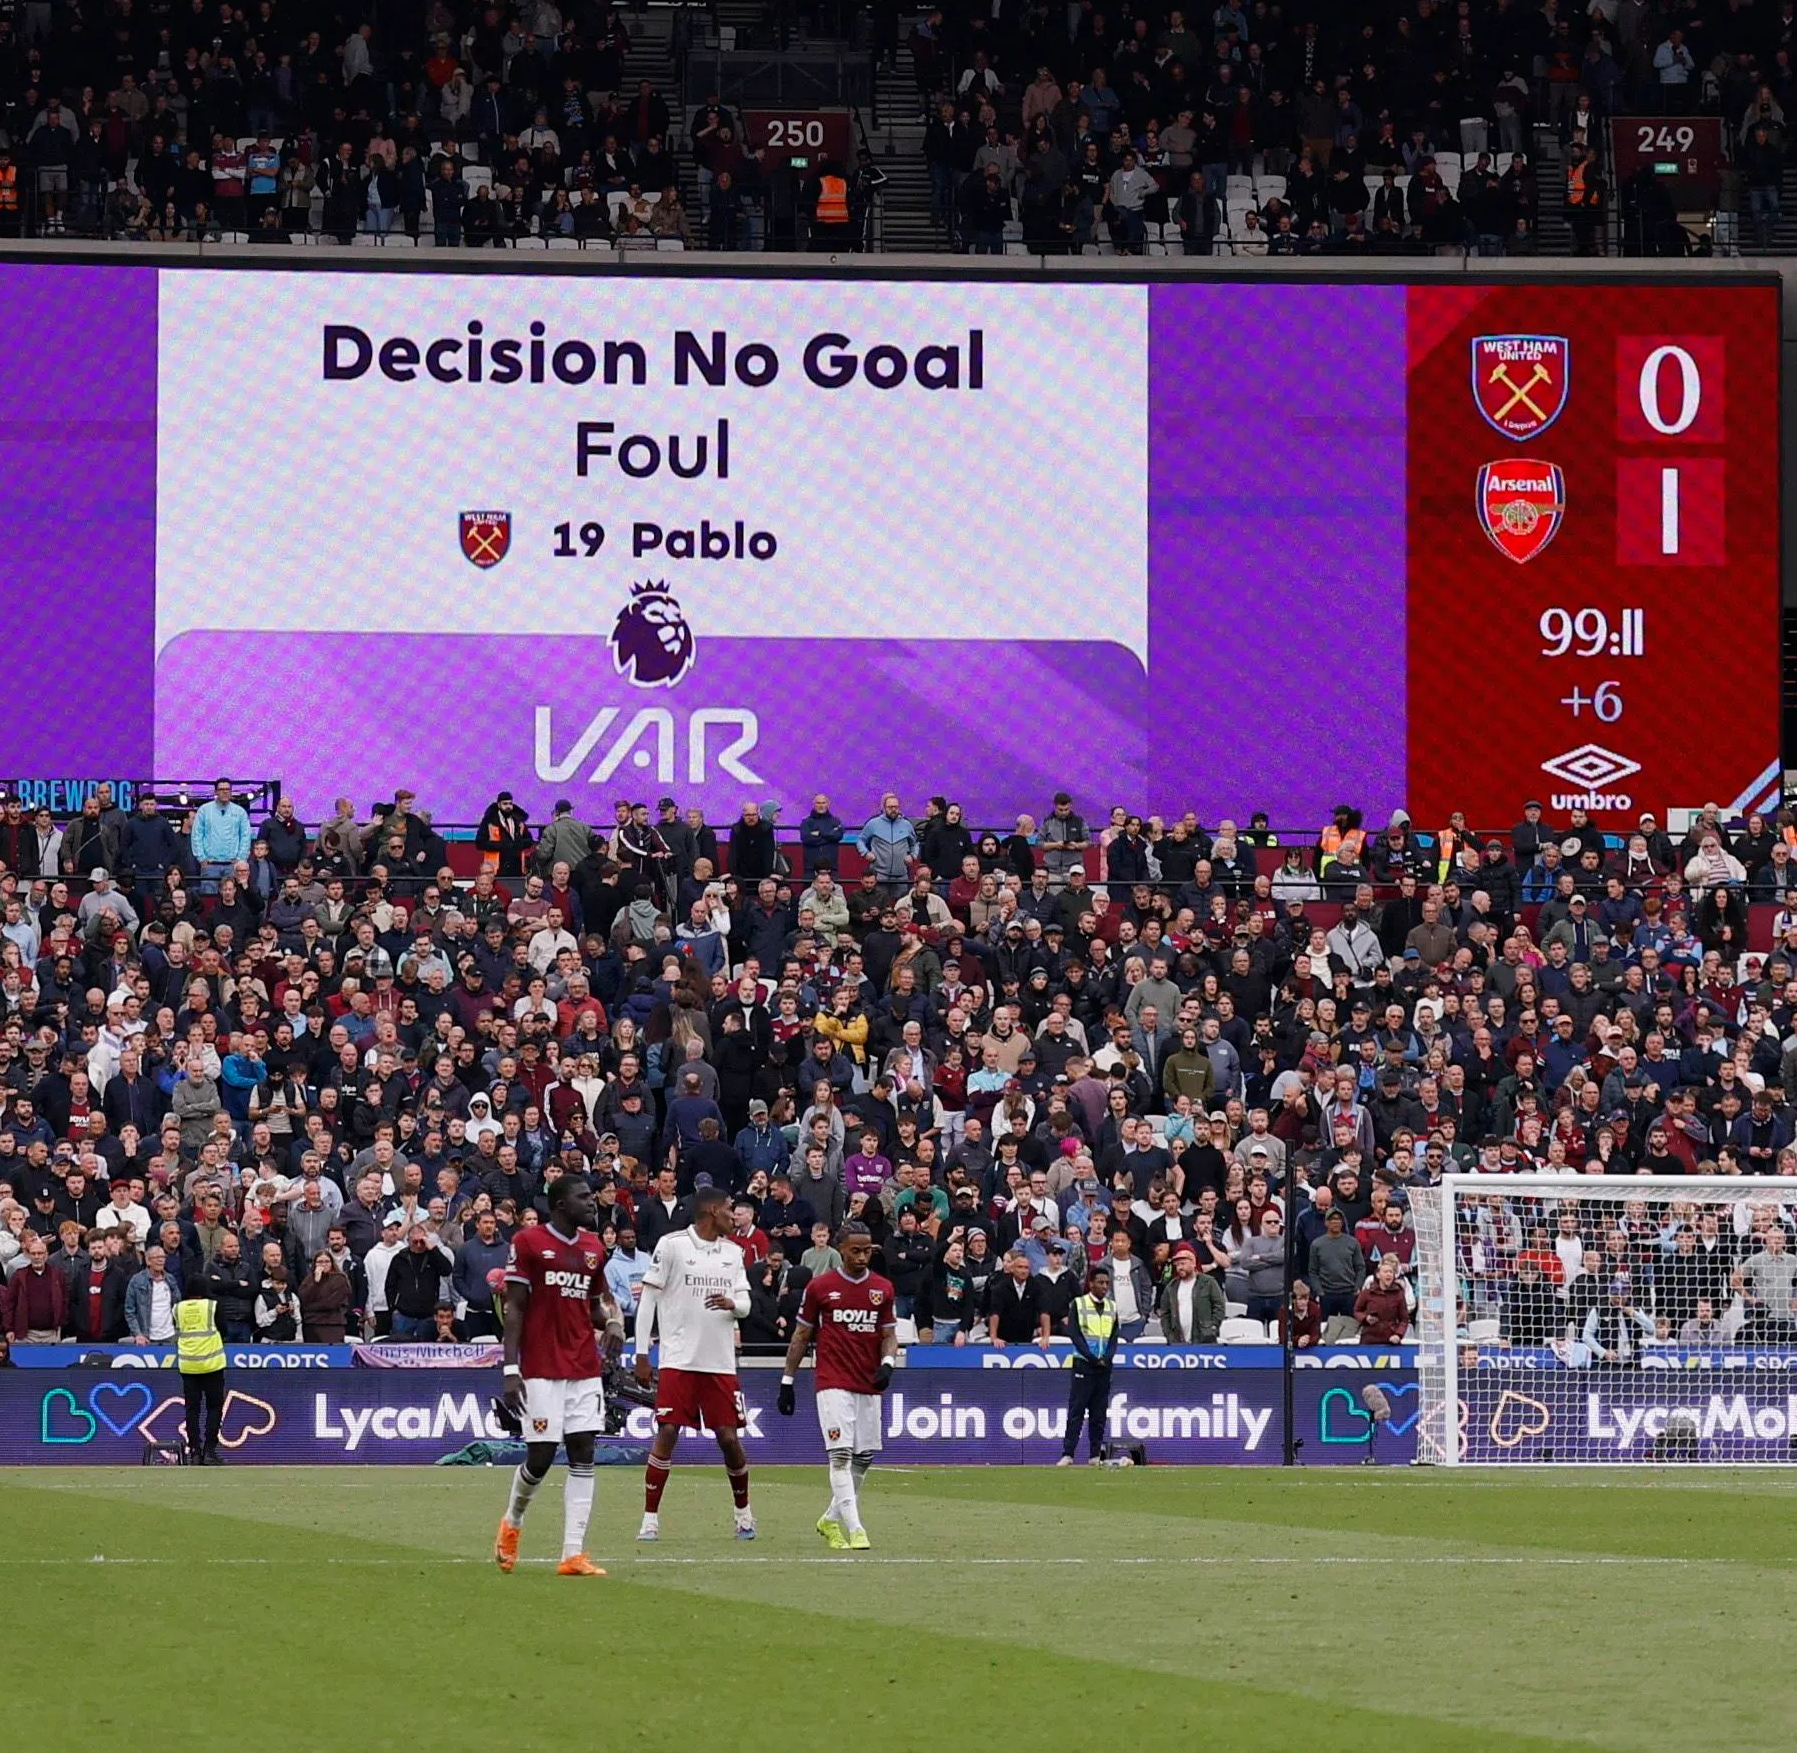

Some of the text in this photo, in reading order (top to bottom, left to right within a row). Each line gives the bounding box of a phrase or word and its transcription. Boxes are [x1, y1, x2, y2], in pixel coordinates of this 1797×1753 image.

[767, 121, 824, 148] 250
[1638, 127, 1694, 153] 249
[322, 320, 984, 390] Decision No Goal
[1483, 340, 1558, 355] WEST HAM
[1639, 345, 1701, 435] 0
[576, 417, 730, 479] Foul
[1487, 474, 1554, 493] Arsenal
[553, 519, 778, 561] 19 Pablo
[1561, 680, 1623, 722] +6
[534, 705, 765, 785] VAR
[1551, 792, 1632, 811] umbro
[545, 1271, 592, 1290] BOYLE
[684, 1274, 732, 1287] Emirates
[560, 1287, 588, 1299] SPORTS
[833, 1309, 879, 1324] BOYLE
[847, 1323, 876, 1334] SPORTS
[416, 1344, 485, 1359] Mitchell
[887, 1393, 987, 1440] Join
[1105, 1393, 1273, 1452] family
